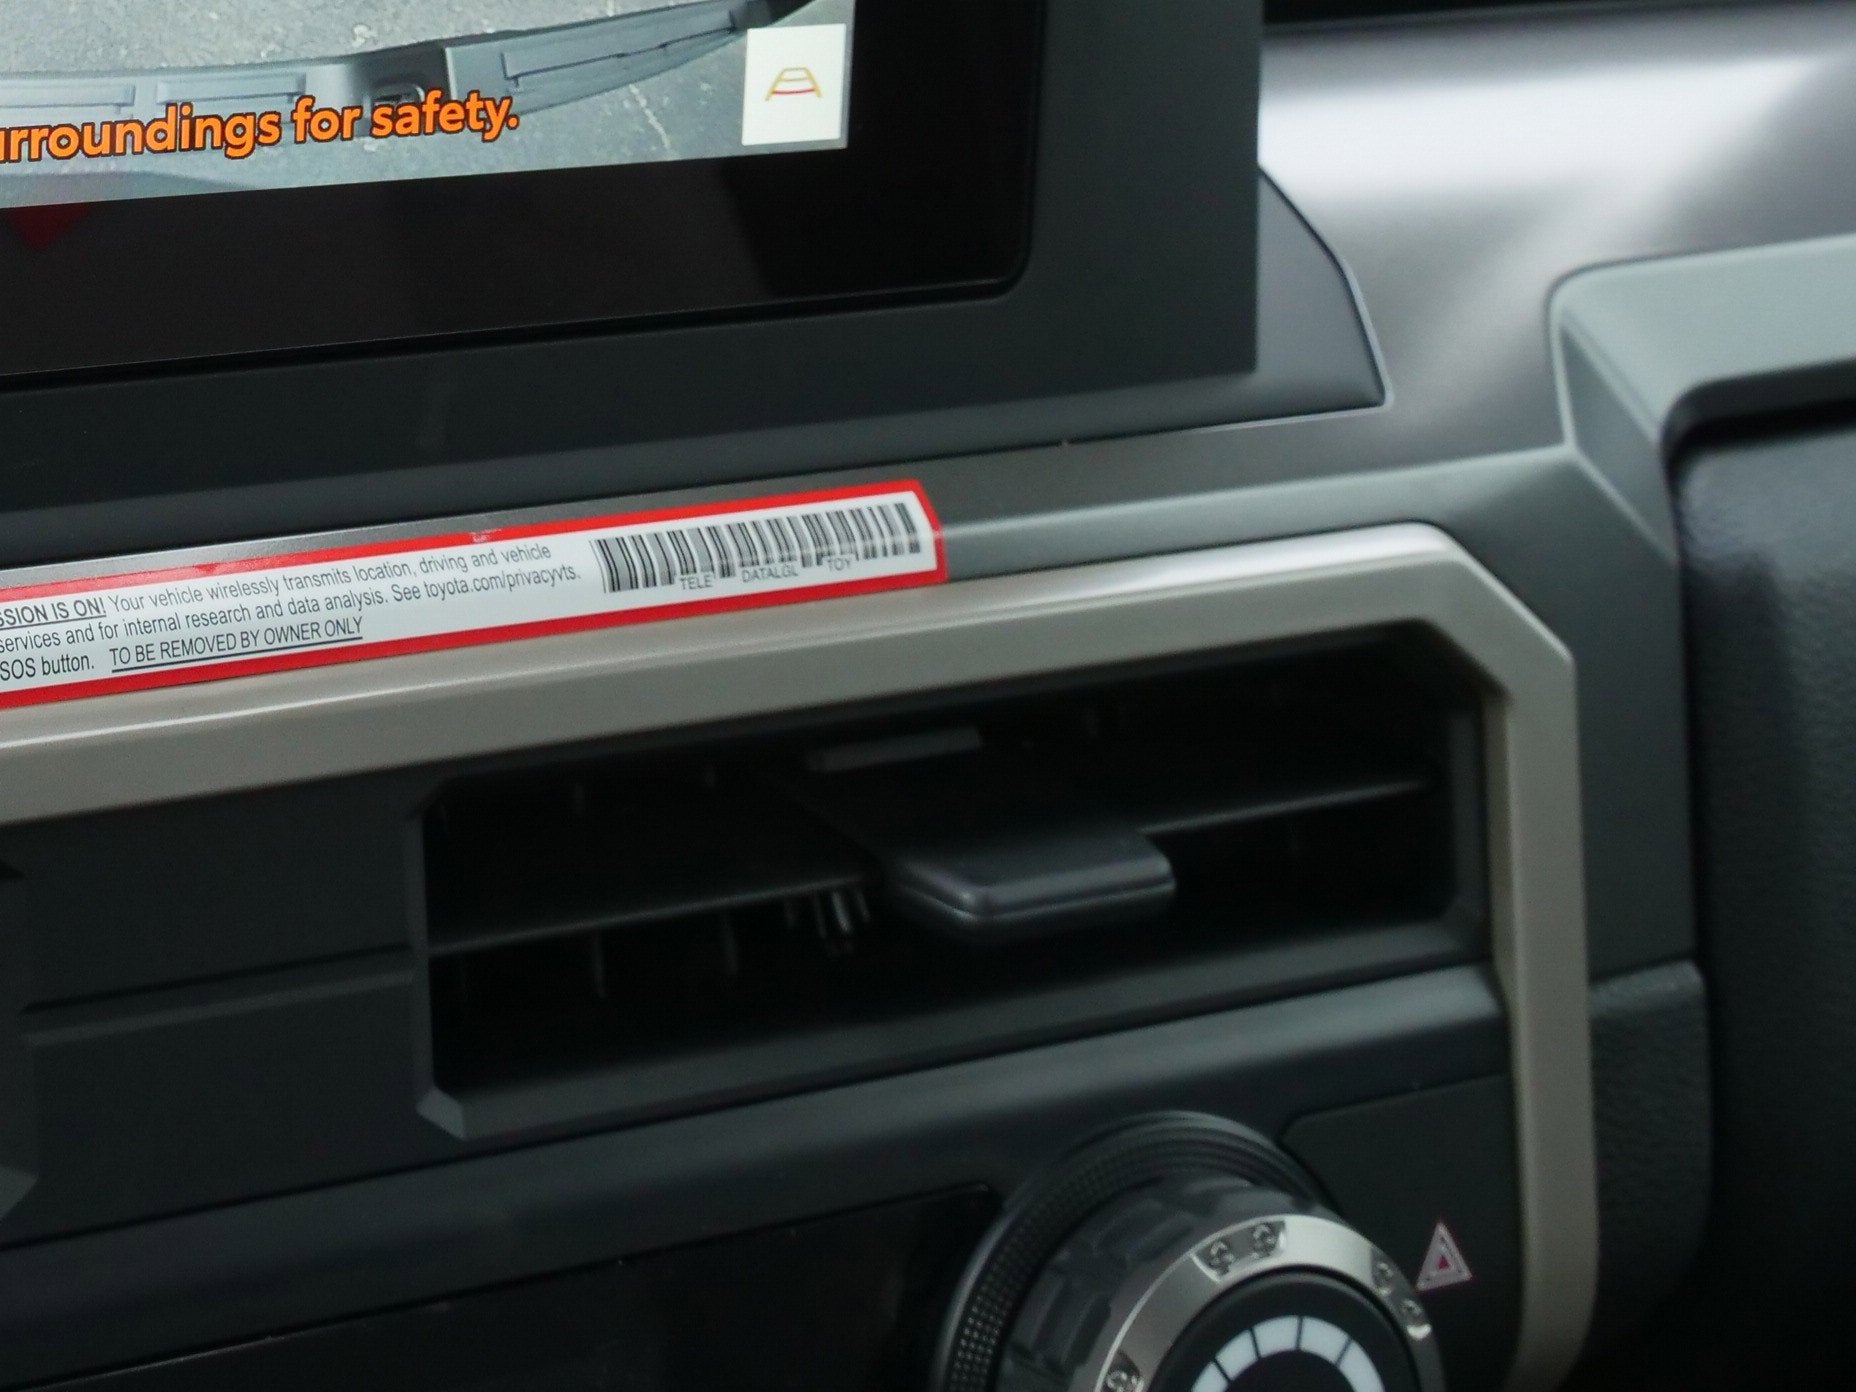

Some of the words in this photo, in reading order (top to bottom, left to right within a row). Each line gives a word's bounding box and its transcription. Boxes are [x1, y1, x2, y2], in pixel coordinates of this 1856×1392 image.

[292, 95, 362, 143] for
[369, 90, 520, 143] safety.
[51, 602, 70, 620] IS
[73, 597, 106, 617] ON!
[108, 595, 144, 612] Your
[150, 582, 204, 607] vehicle
[207, 577, 279, 600] wirelessly
[283, 569, 351, 591] transmits
[353, 557, 417, 582] location,
[420, 555, 468, 574] driving
[472, 549, 498, 567] and
[501, 543, 552, 563] vehicle
[66, 622, 94, 643] and
[99, 619, 119, 640] for
[123, 612, 181, 636] internal
[186, 607, 252, 628] research
[256, 602, 284, 620] and
[288, 598, 321, 614] data
[324, 588, 388, 611] analysis.
[391, 584, 421, 602] See
[426, 564, 581, 601] toyota.com/privacyvts.
[680, 573, 713, 590] TELE
[827, 557, 852, 572] TOY
[0, 657, 36, 681] SOS
[42, 653, 94, 676] button.
[109, 647, 130, 666] TO
[135, 643, 156, 662] BE
[160, 632, 237, 659] REMOVED
[241, 628, 260, 648] BY
[264, 621, 321, 645] OWNER
[324, 616, 363, 637] ONLY
